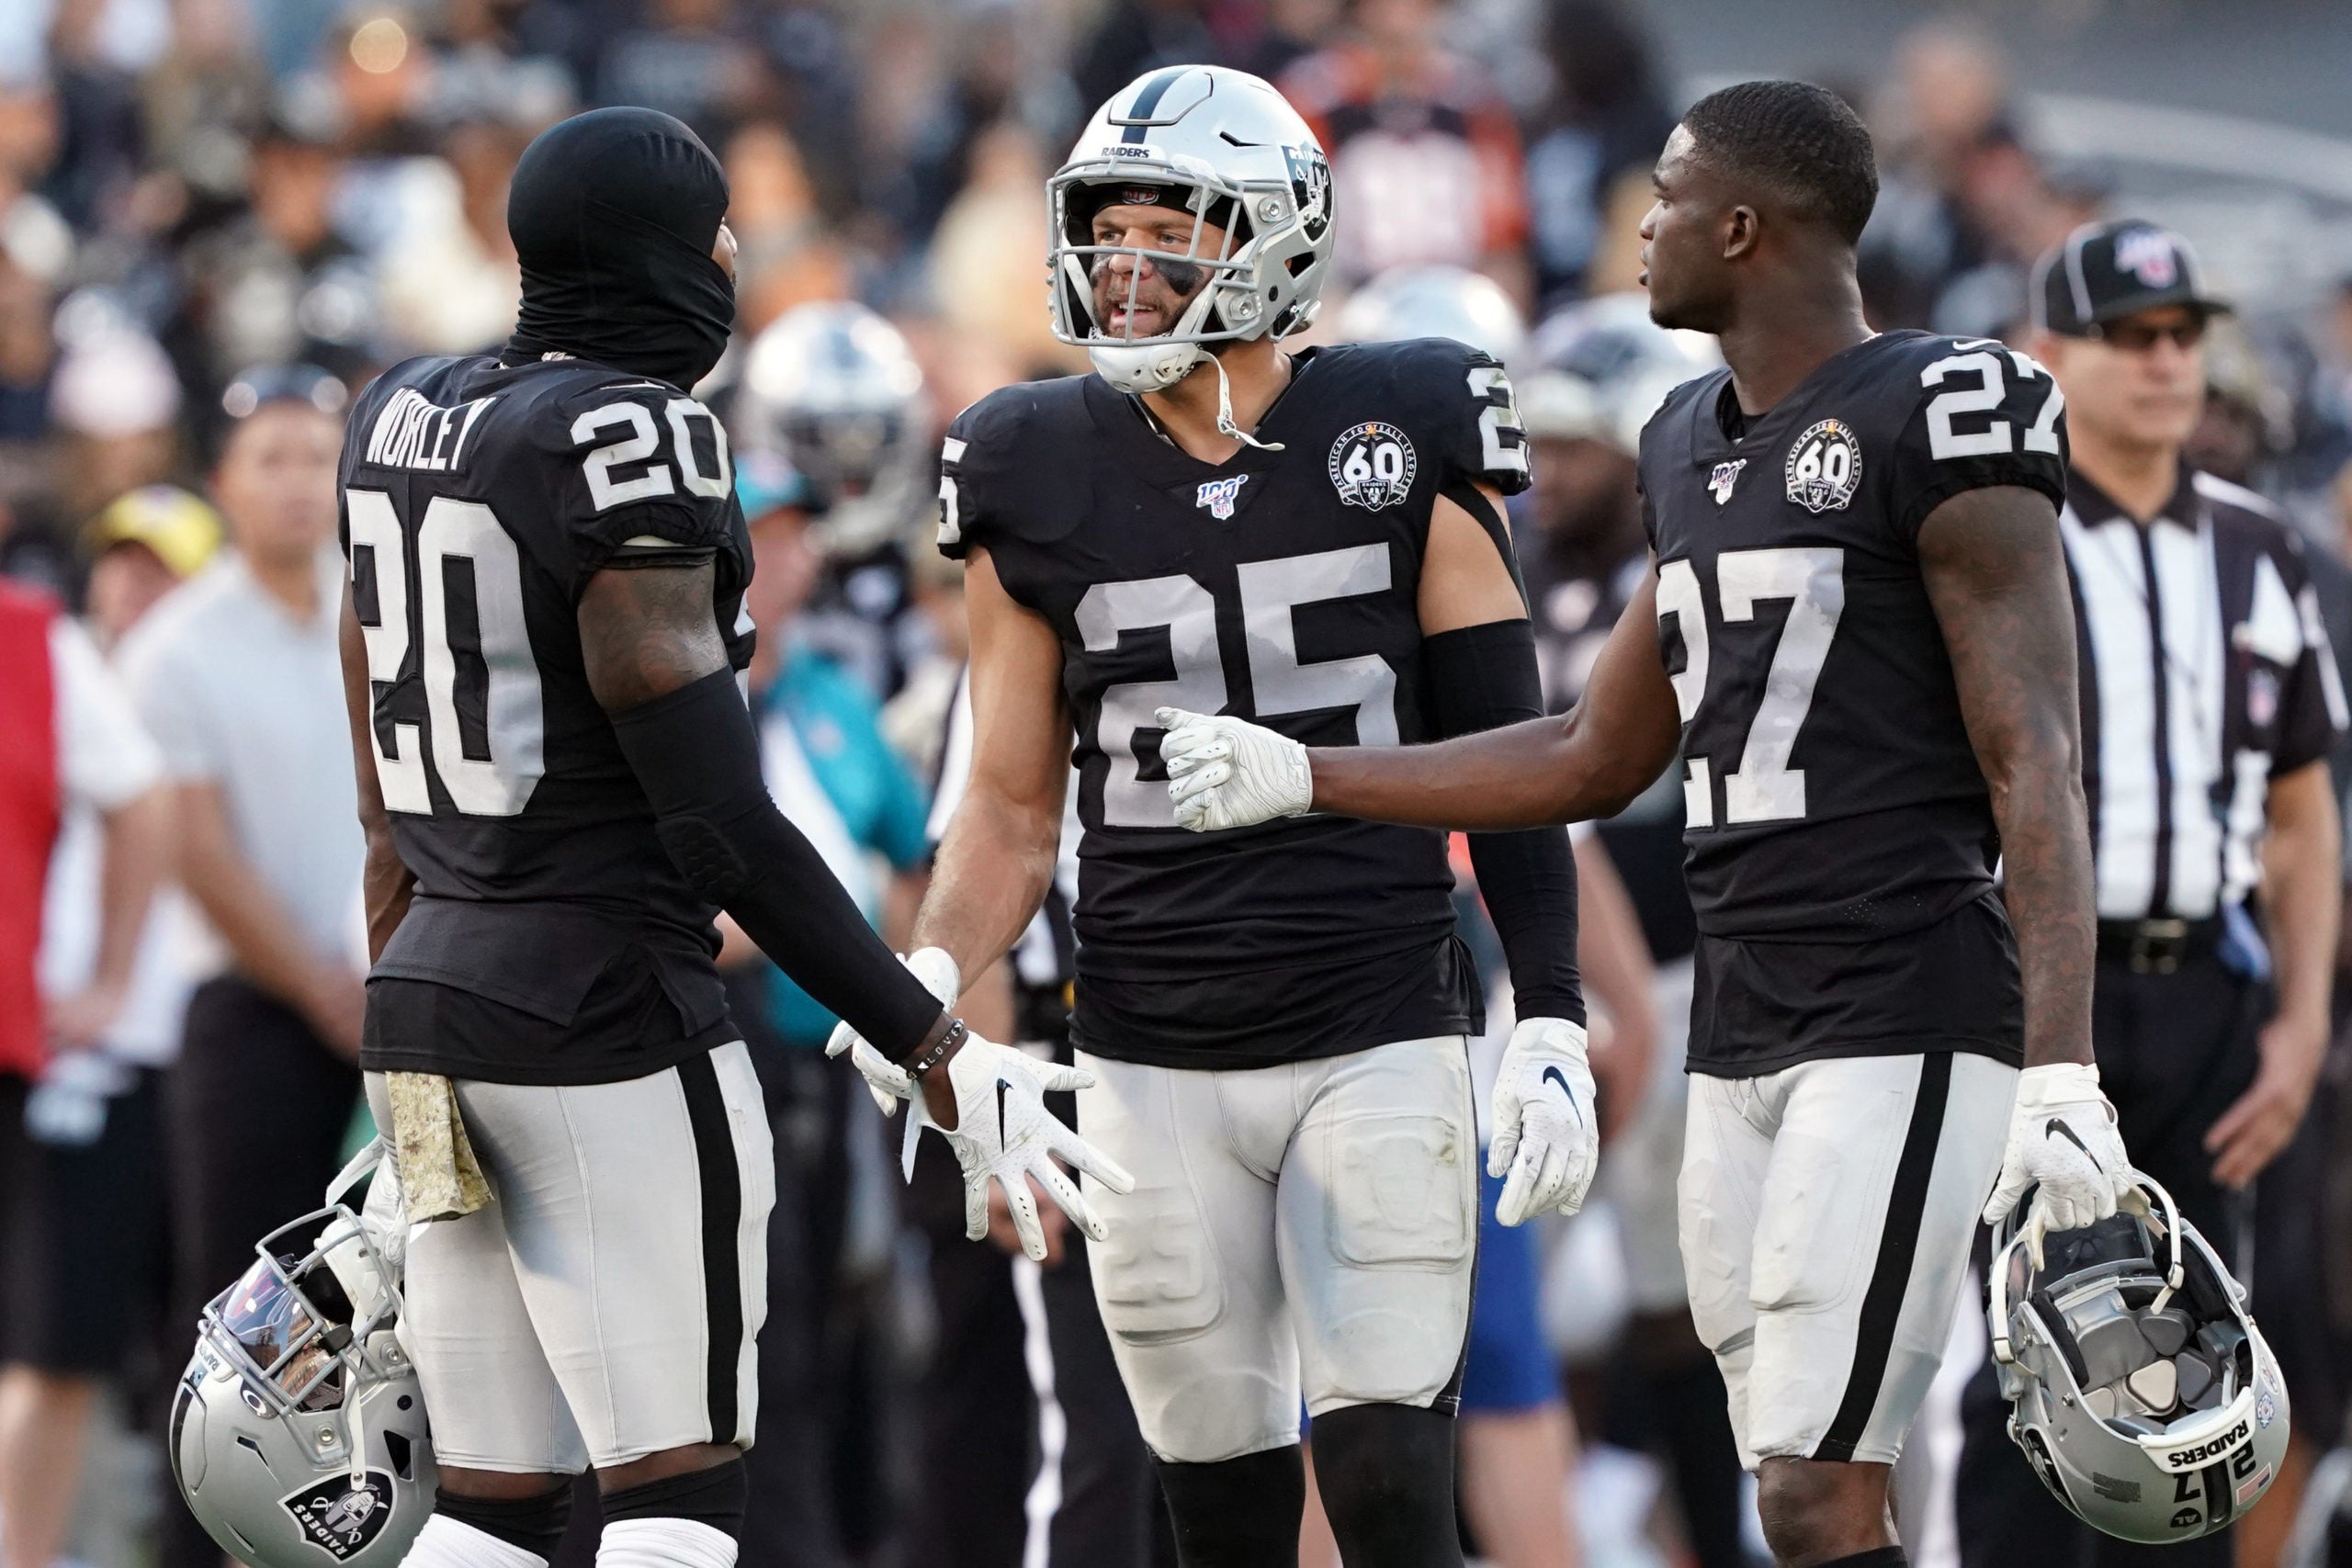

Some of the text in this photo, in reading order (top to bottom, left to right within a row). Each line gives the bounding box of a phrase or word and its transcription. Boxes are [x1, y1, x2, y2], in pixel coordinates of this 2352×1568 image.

[1102, 147, 1150, 159] RAIDERS
[1466, 367, 1532, 474] 2
[1920, 350, 2065, 459] 27
[570, 398, 732, 512] 20
[1329, 424, 1415, 489] AMERICAN FOOTBALL LEAGUE
[1342, 442, 1404, 484] 60
[1796, 439, 1851, 487] 60
[345, 488, 545, 816] 20
[1074, 542, 1400, 828] 25
[1655, 547, 1845, 829] 27
[926, 1028, 959, 1064] LOVE
[2168, 1419, 2249, 1468] RAIDERS
[293, 1504, 348, 1556] RAIDERS
